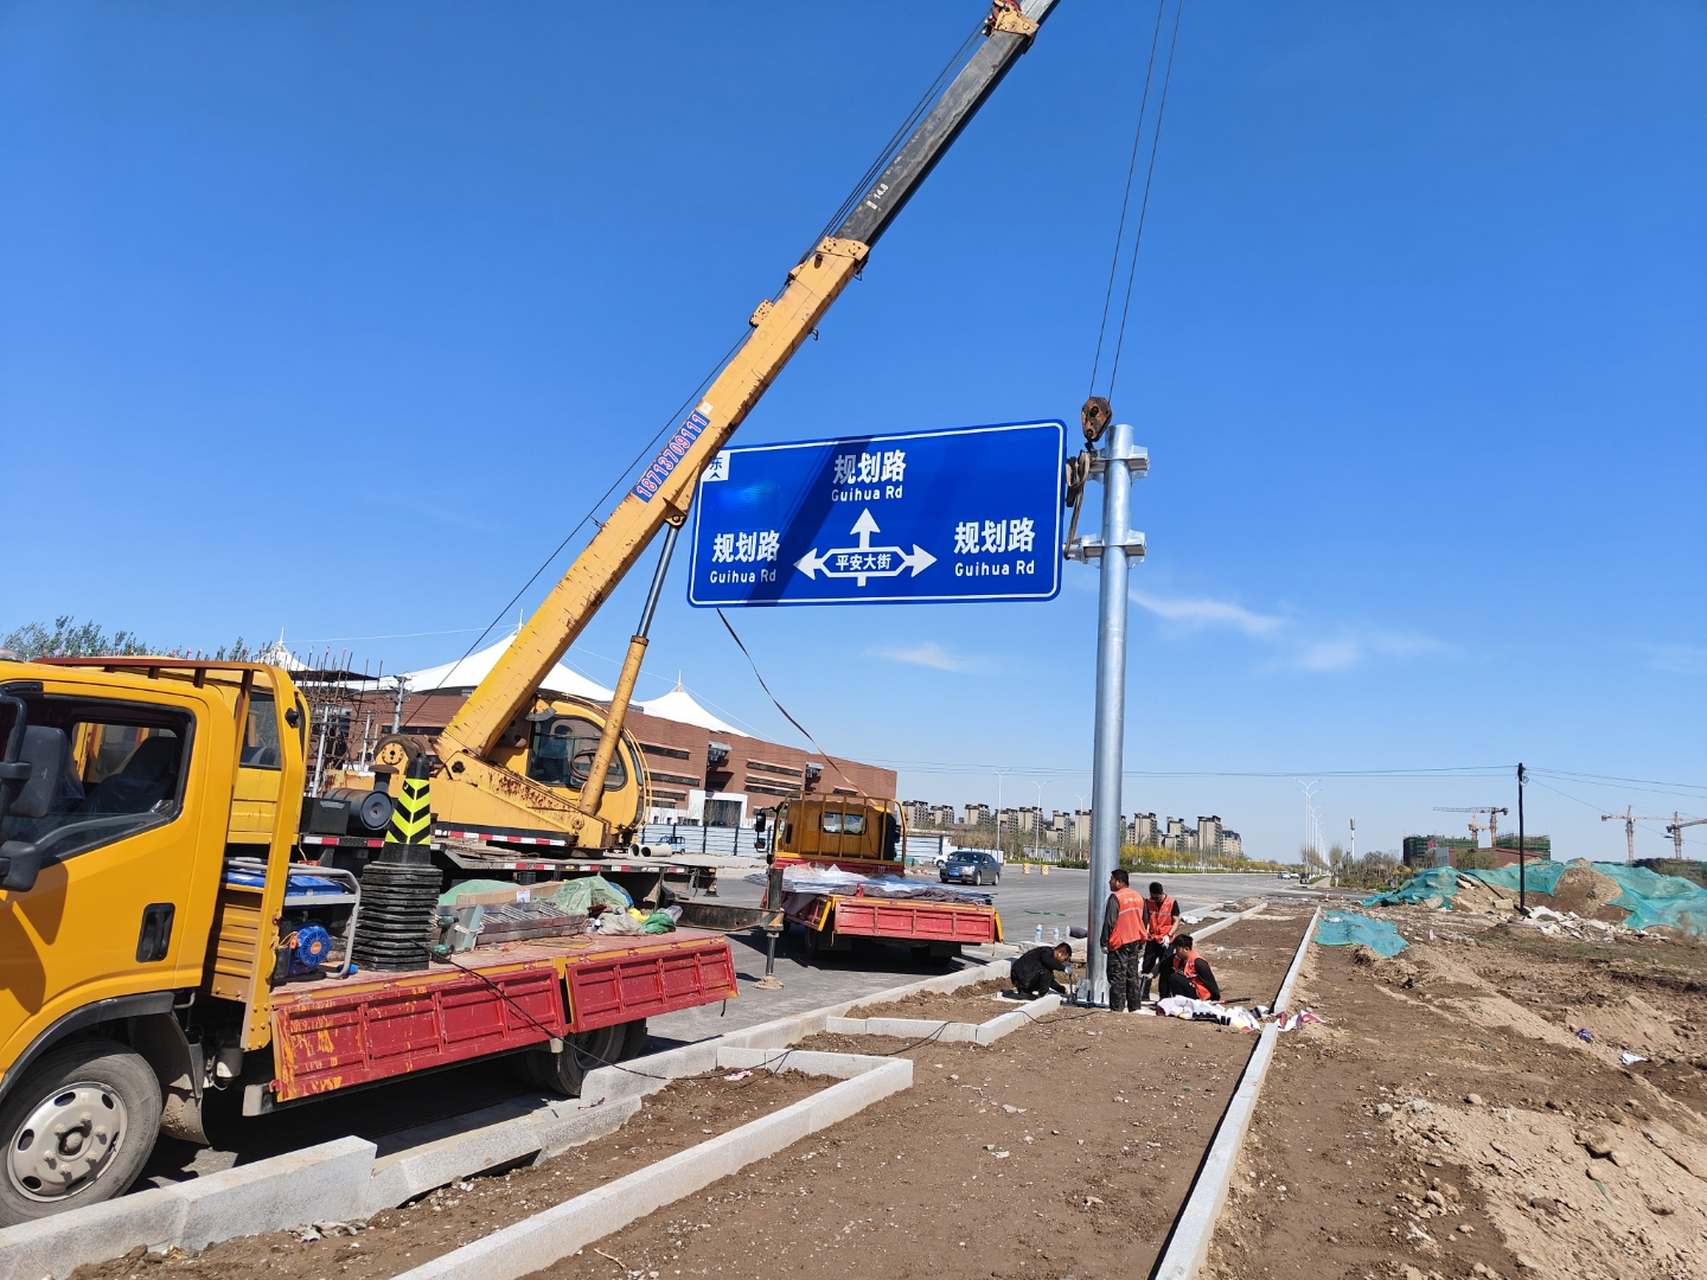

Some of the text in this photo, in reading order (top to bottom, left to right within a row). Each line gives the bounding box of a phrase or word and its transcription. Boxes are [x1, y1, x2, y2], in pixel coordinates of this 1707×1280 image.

[637, 413, 708, 498] 18713709111
[709, 456, 724, 471] 东
[832, 449, 907, 485] 规划路
[831, 484, 903, 502] Guihua Rd
[953, 517, 1036, 554] 规划路
[711, 529, 781, 563] 规划路
[835, 553, 892, 571] 平安大街
[955, 559, 1035, 577] Guihua Rd
[709, 568, 777, 584] Guihua Rd
